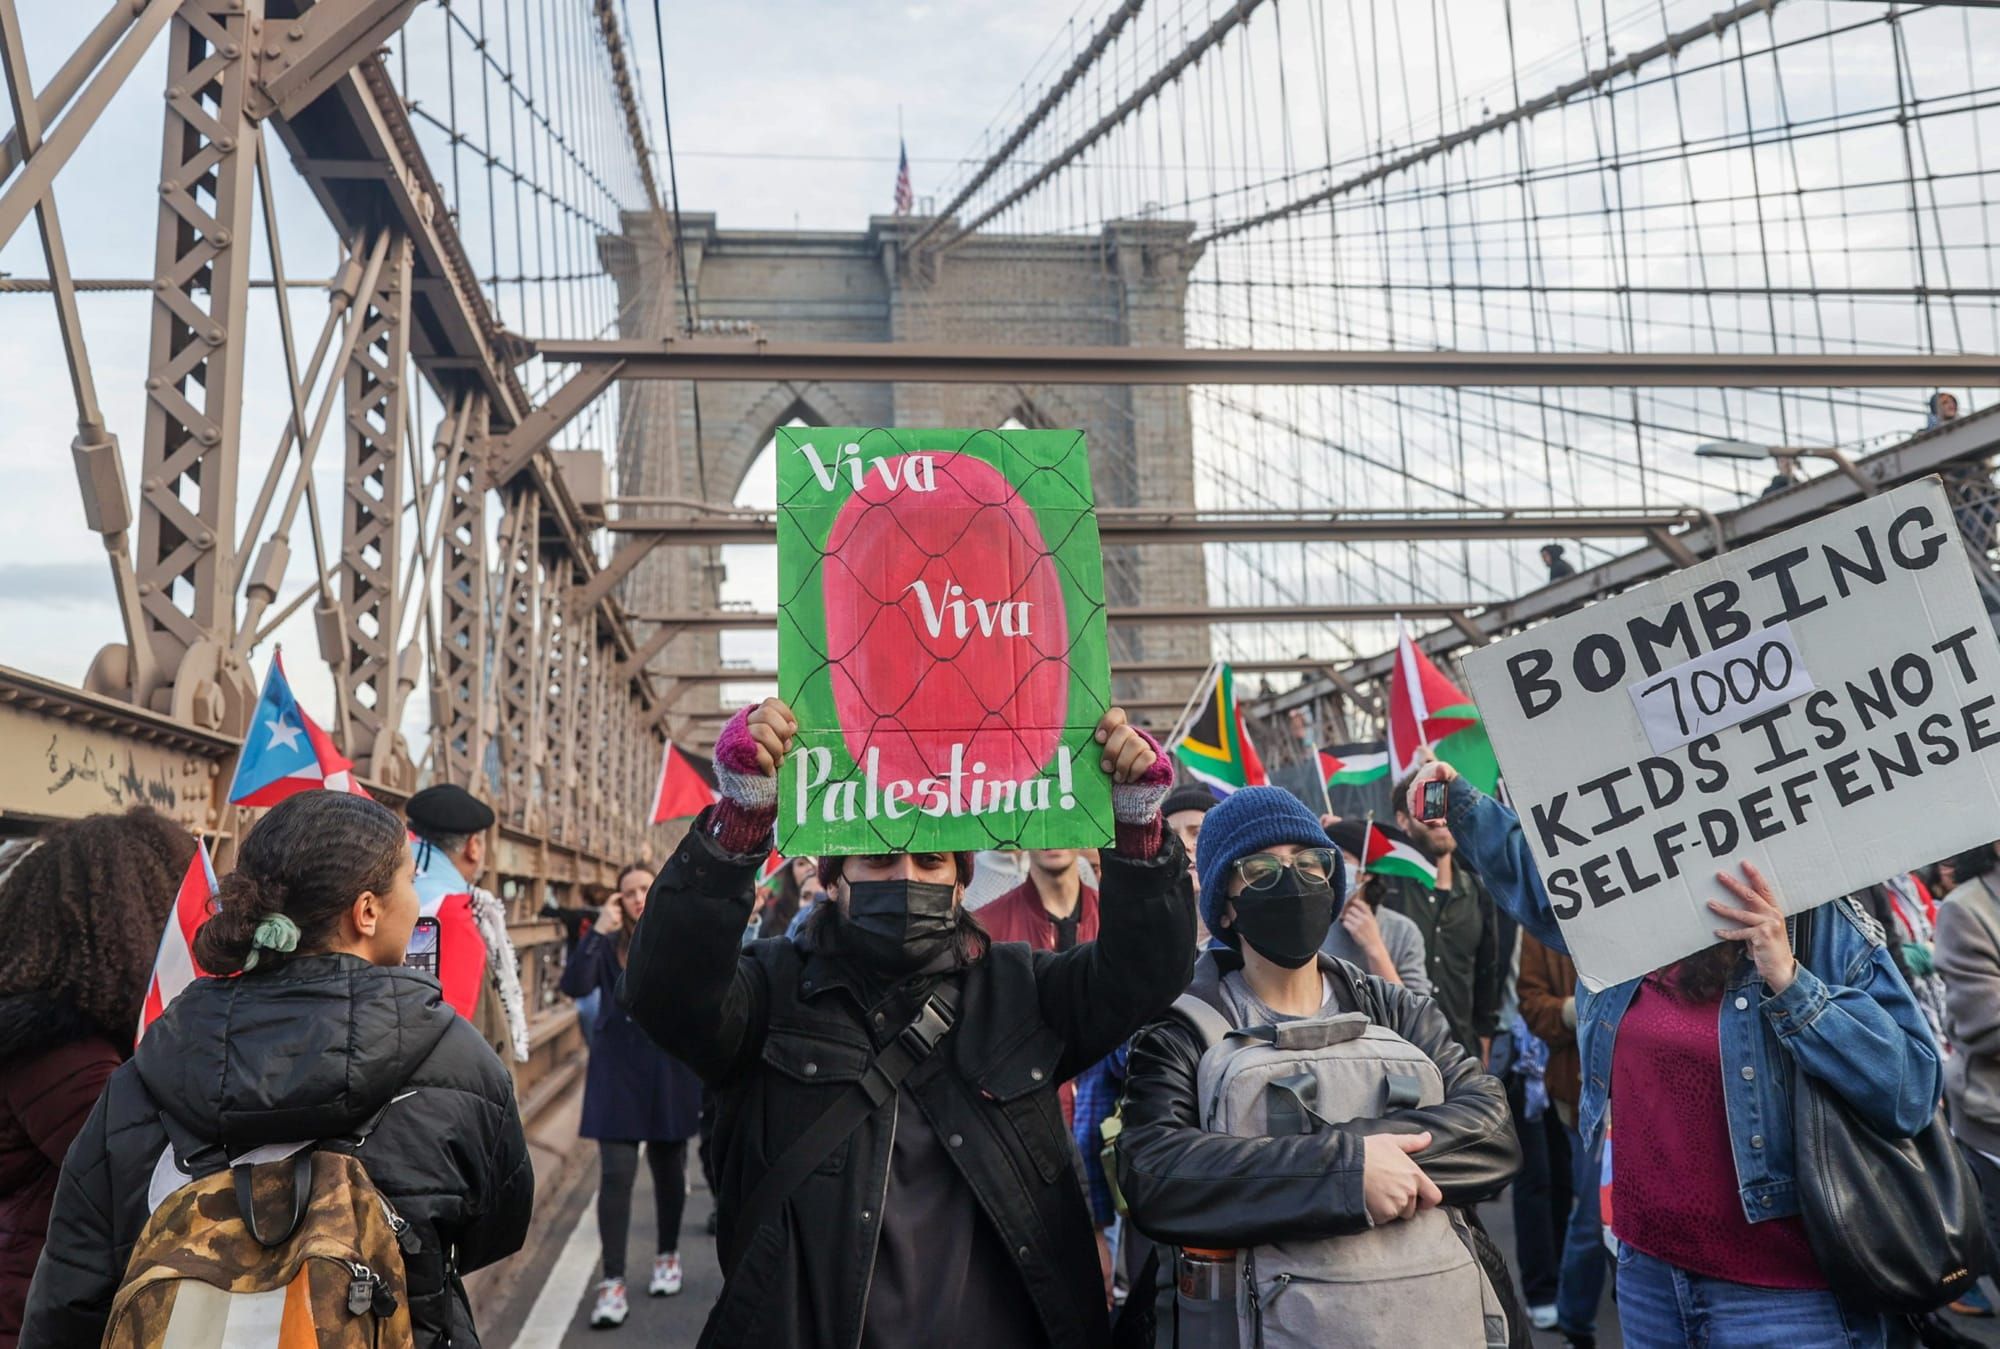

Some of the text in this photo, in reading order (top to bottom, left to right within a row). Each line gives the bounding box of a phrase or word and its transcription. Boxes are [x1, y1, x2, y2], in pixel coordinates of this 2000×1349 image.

[792, 442, 940, 492] Viva
[902, 579, 1034, 639] Viva
[1506, 505, 1948, 719] BOMBING
[788, 743, 1075, 825] Palestina!
[1531, 626, 1978, 858] KIDS IS NOT
[1547, 694, 2000, 921] SELF-DEFENSE
